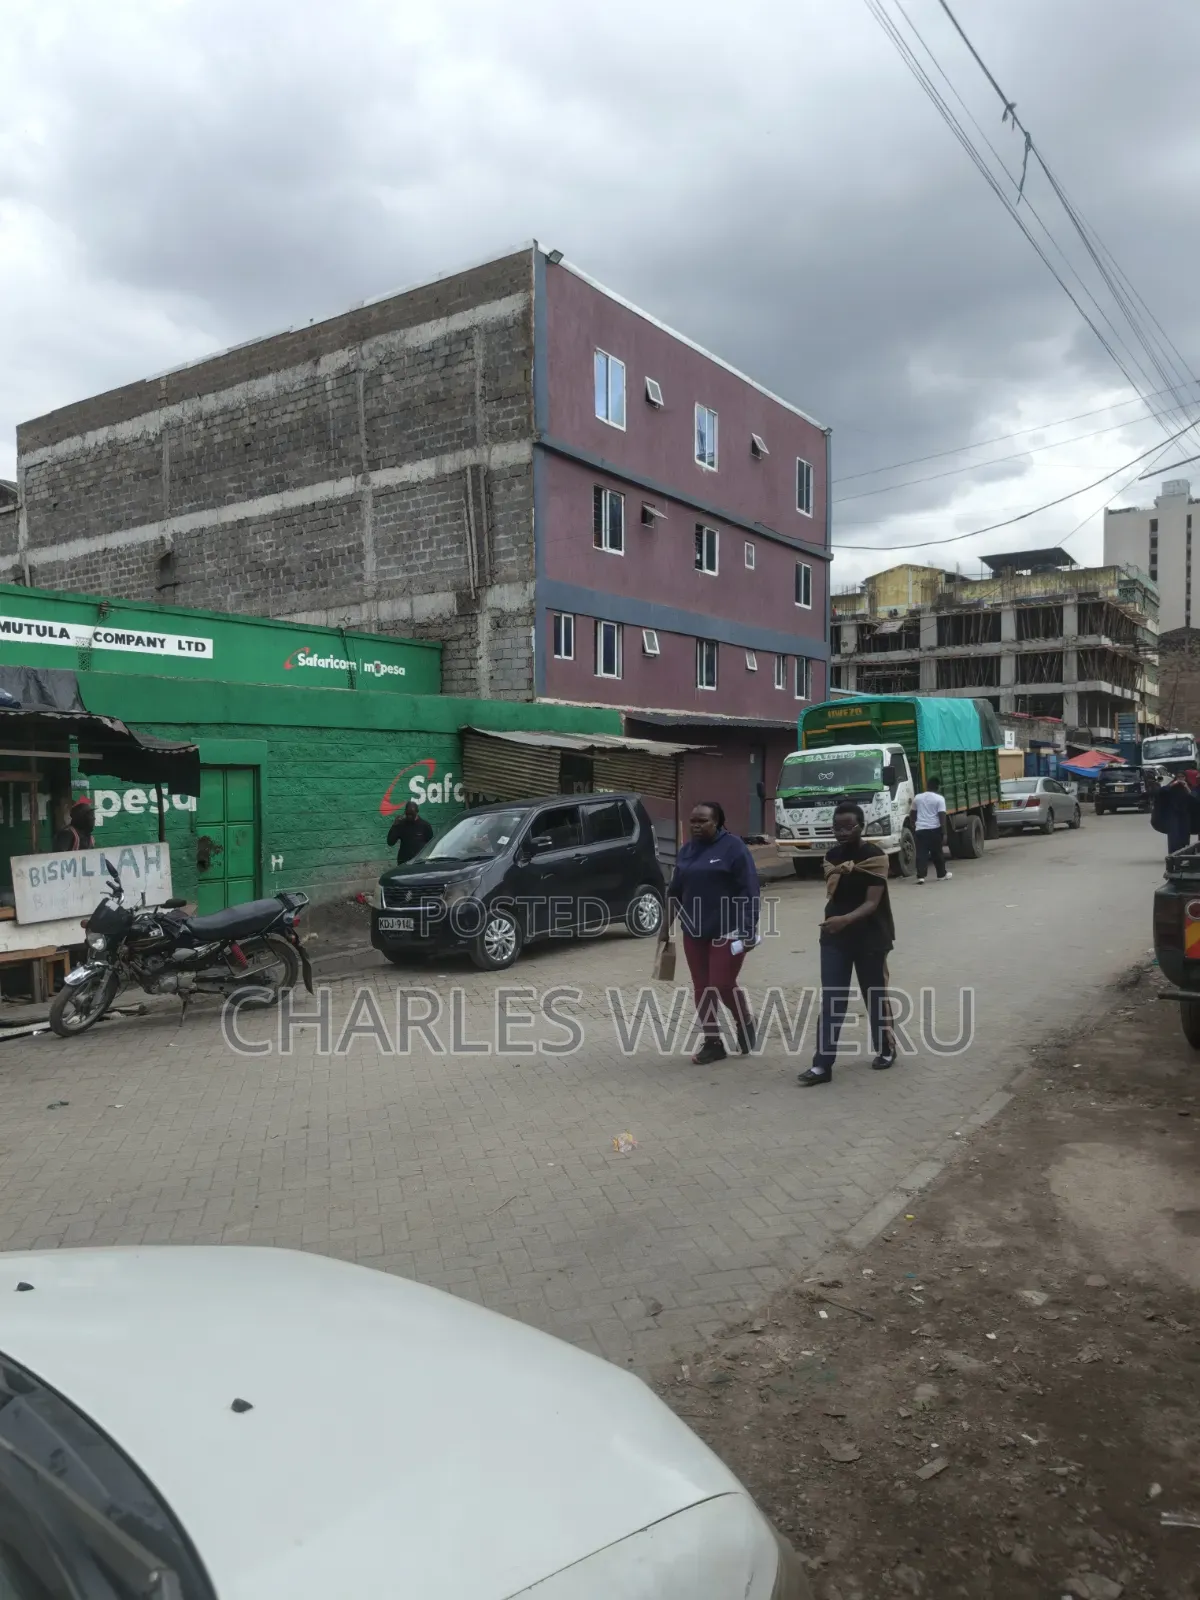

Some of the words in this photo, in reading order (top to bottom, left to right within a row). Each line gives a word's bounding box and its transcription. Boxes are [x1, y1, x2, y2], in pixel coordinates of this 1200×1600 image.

[0, 621, 71, 639] MUTULA
[93, 631, 166, 649] COMPANY
[178, 640, 206, 652] LTD
[297, 653, 357, 671] Safaricom
[379, 919, 394, 929] KDJ
